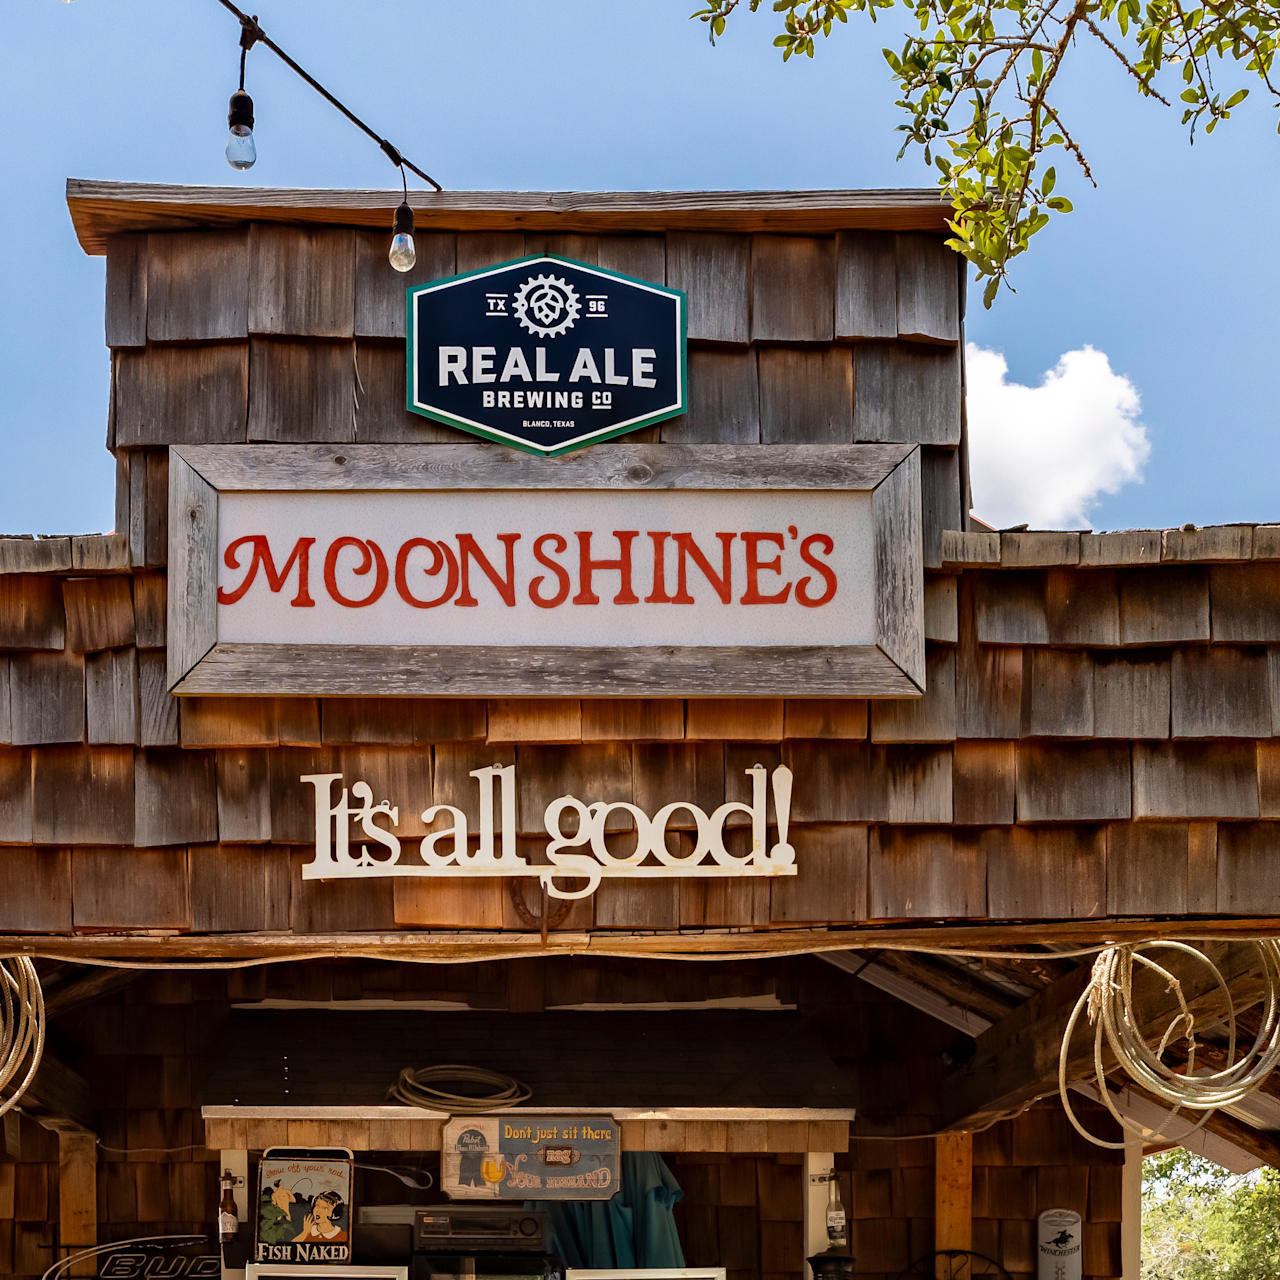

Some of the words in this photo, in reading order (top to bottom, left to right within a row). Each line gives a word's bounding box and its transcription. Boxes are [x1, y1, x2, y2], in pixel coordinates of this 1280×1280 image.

[487, 298, 506, 311] TX
[588, 300, 605, 312] 96
[438, 346, 560, 387] REAL
[569, 347, 658, 389] ALE
[482, 391, 583, 409] BREWING
[591, 391, 612, 409] CO
[522, 420, 552, 428] BLANCO,
[553, 420, 575, 428] TEXAS
[218, 526, 838, 609] MOONSHINE'S
[300, 772, 400, 868] It's
[420, 764, 526, 868] all
[544, 764, 797, 900] good!
[504, 1125, 531, 1139] Don't
[531, 1125, 557, 1144] just
[562, 1125, 578, 1139] sit
[582, 1125, 612, 1140] there
[257, 1242, 292, 1261] FISH
[295, 1243, 349, 1262] NAKED
[100, 1254, 222, 1279] BUD
